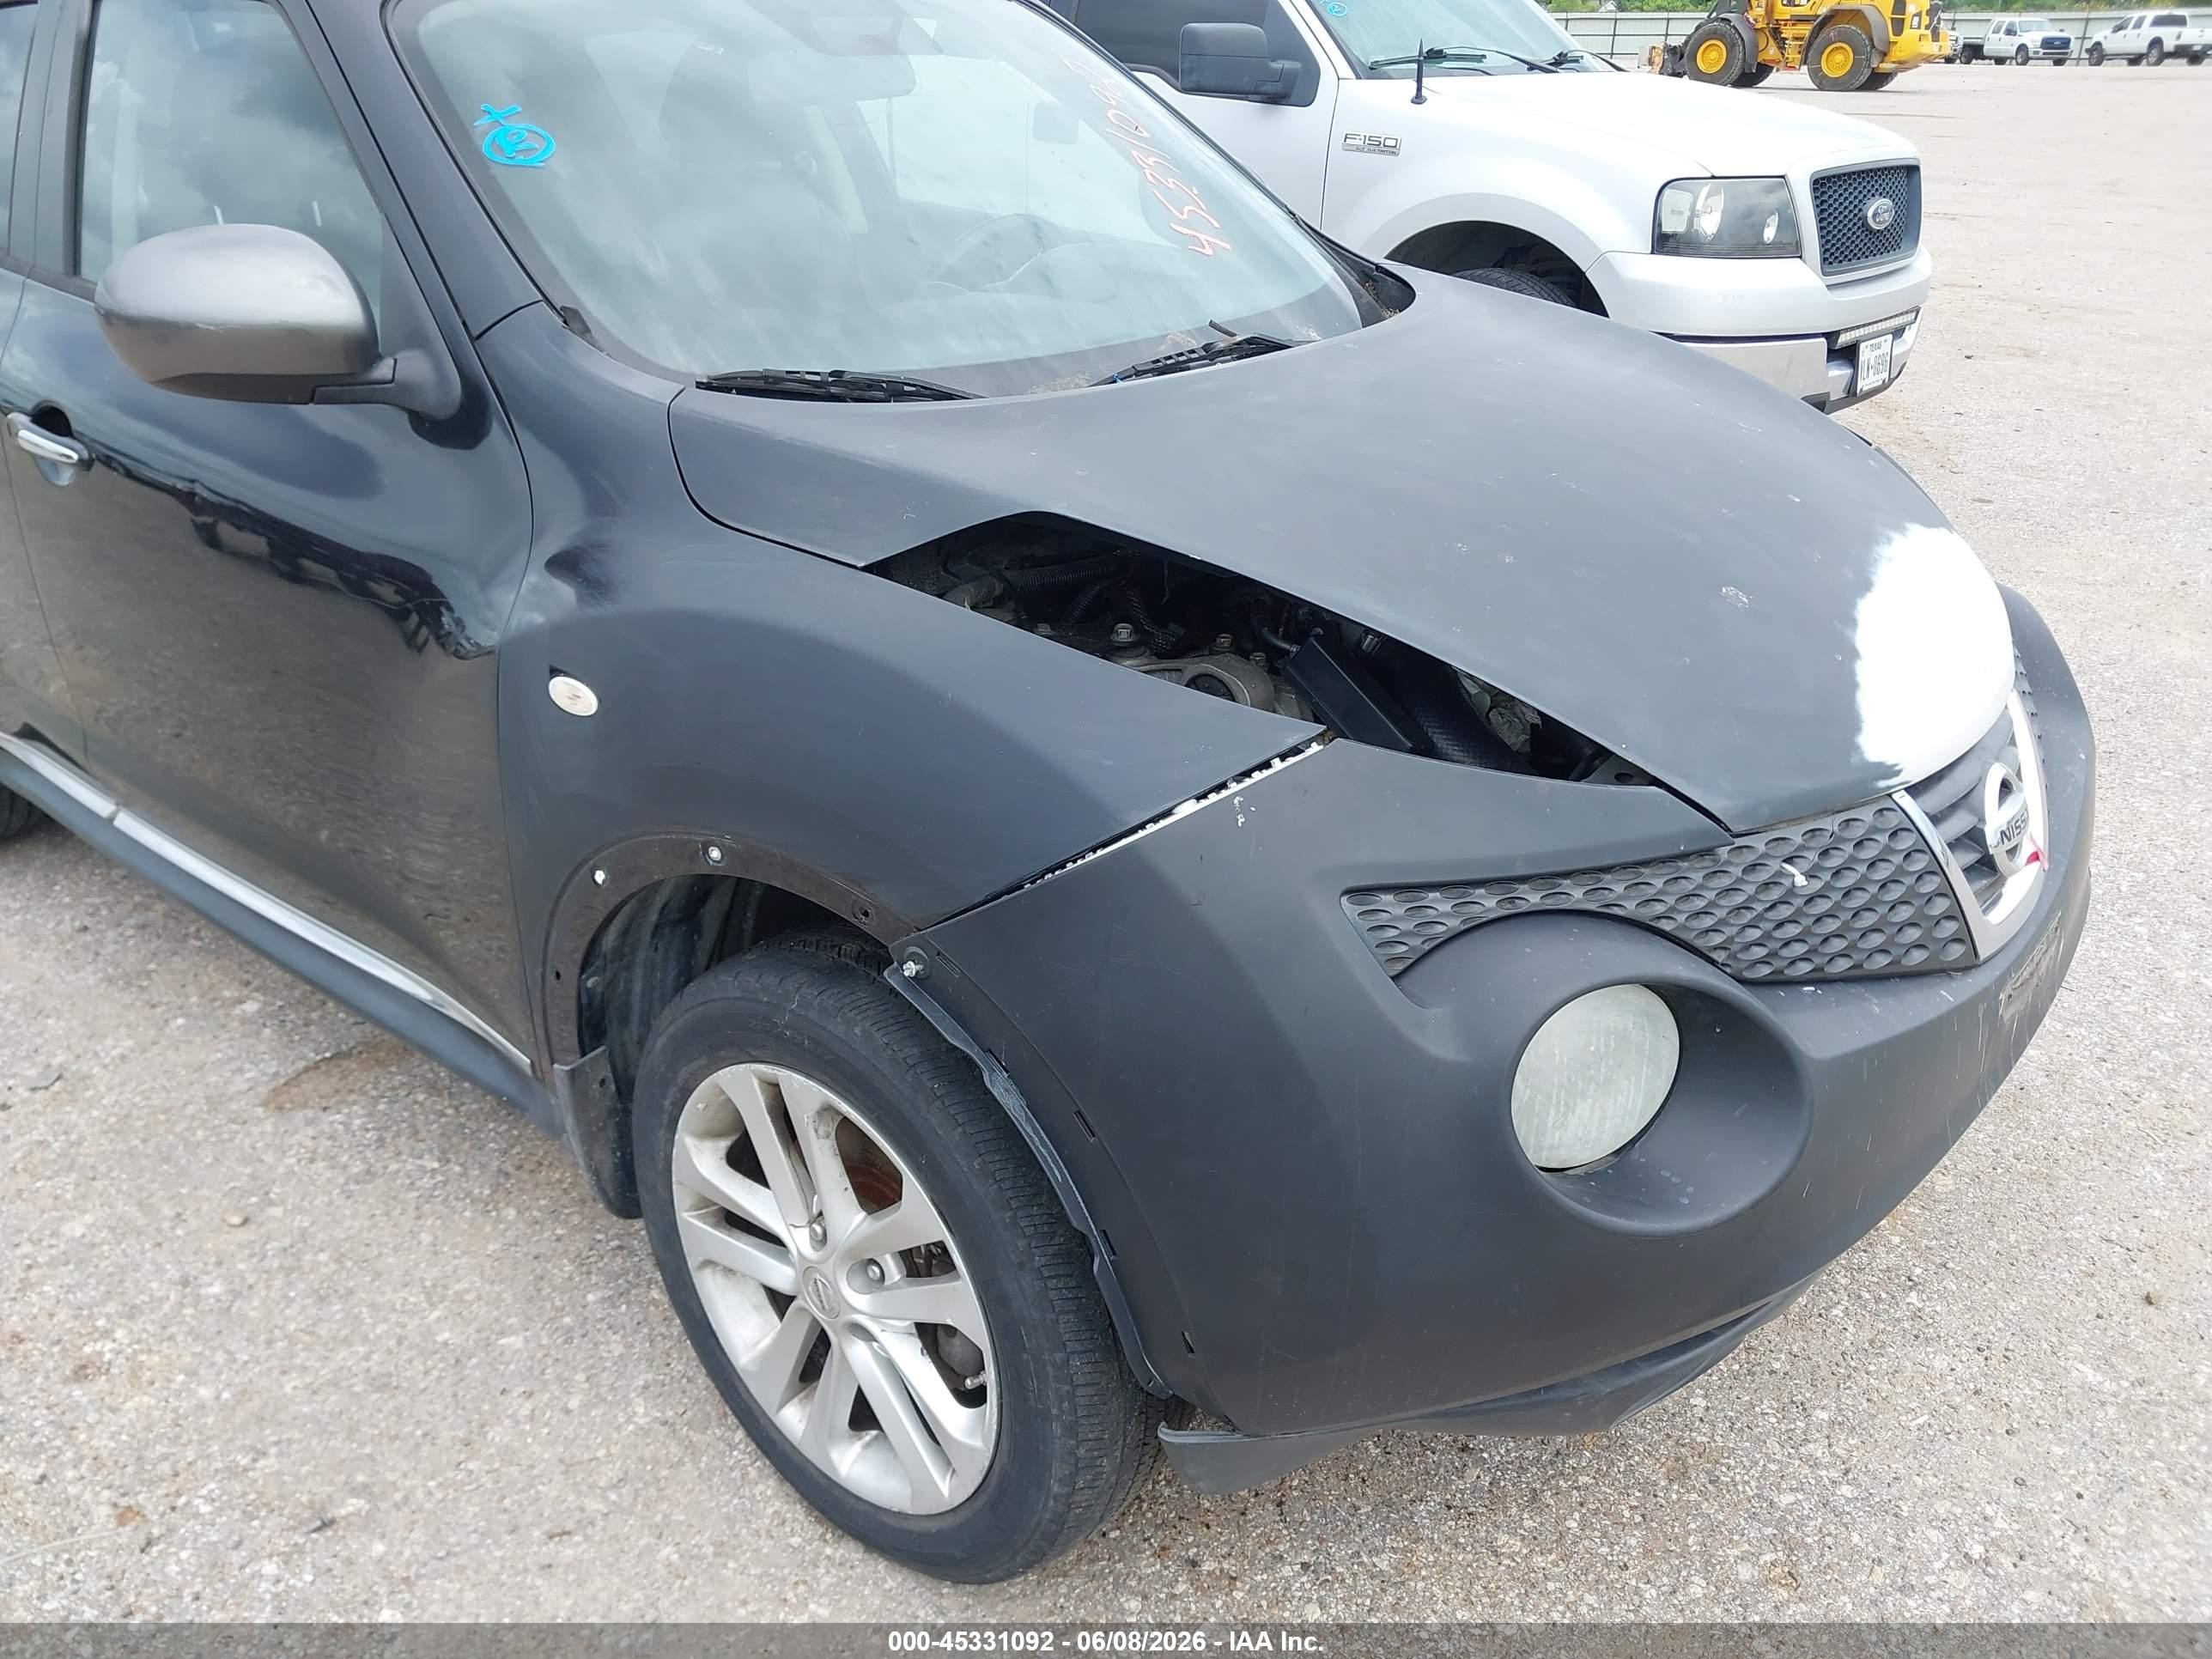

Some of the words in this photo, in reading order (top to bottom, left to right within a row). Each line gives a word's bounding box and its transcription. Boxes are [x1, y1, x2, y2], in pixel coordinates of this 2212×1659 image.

[1344, 133, 1398, 148] F-150
[1869, 340, 1882, 352] TEXAS
[2000, 811, 2028, 845] NISS
